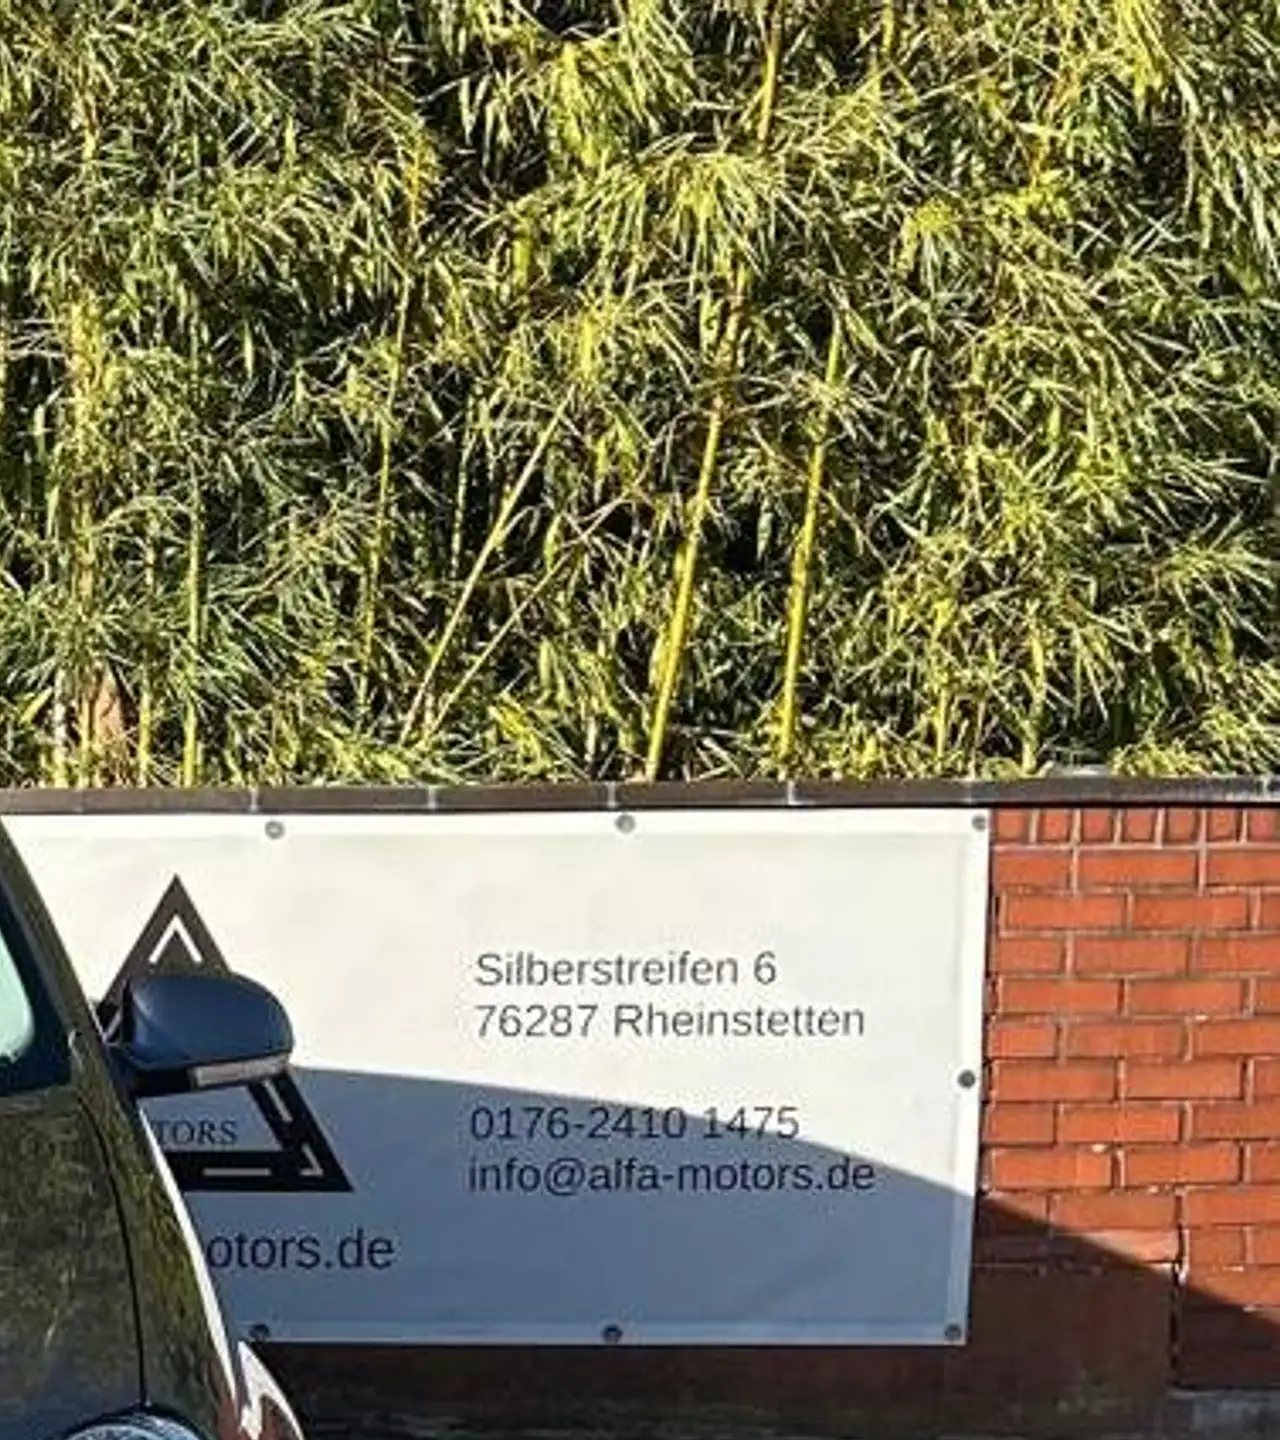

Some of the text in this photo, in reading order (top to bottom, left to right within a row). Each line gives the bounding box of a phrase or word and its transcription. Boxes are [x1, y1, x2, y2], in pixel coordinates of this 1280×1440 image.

[474, 950, 778, 987] Silberstreifen 6
[476, 1003, 866, 1038] 76287 Rheinstetten
[151, 1119, 238, 1146] TORS
[470, 1105, 801, 1141] 0176-2410 1475
[469, 1156, 877, 1197] info@alfa-motors.de
[206, 1227, 394, 1270] otors.de
